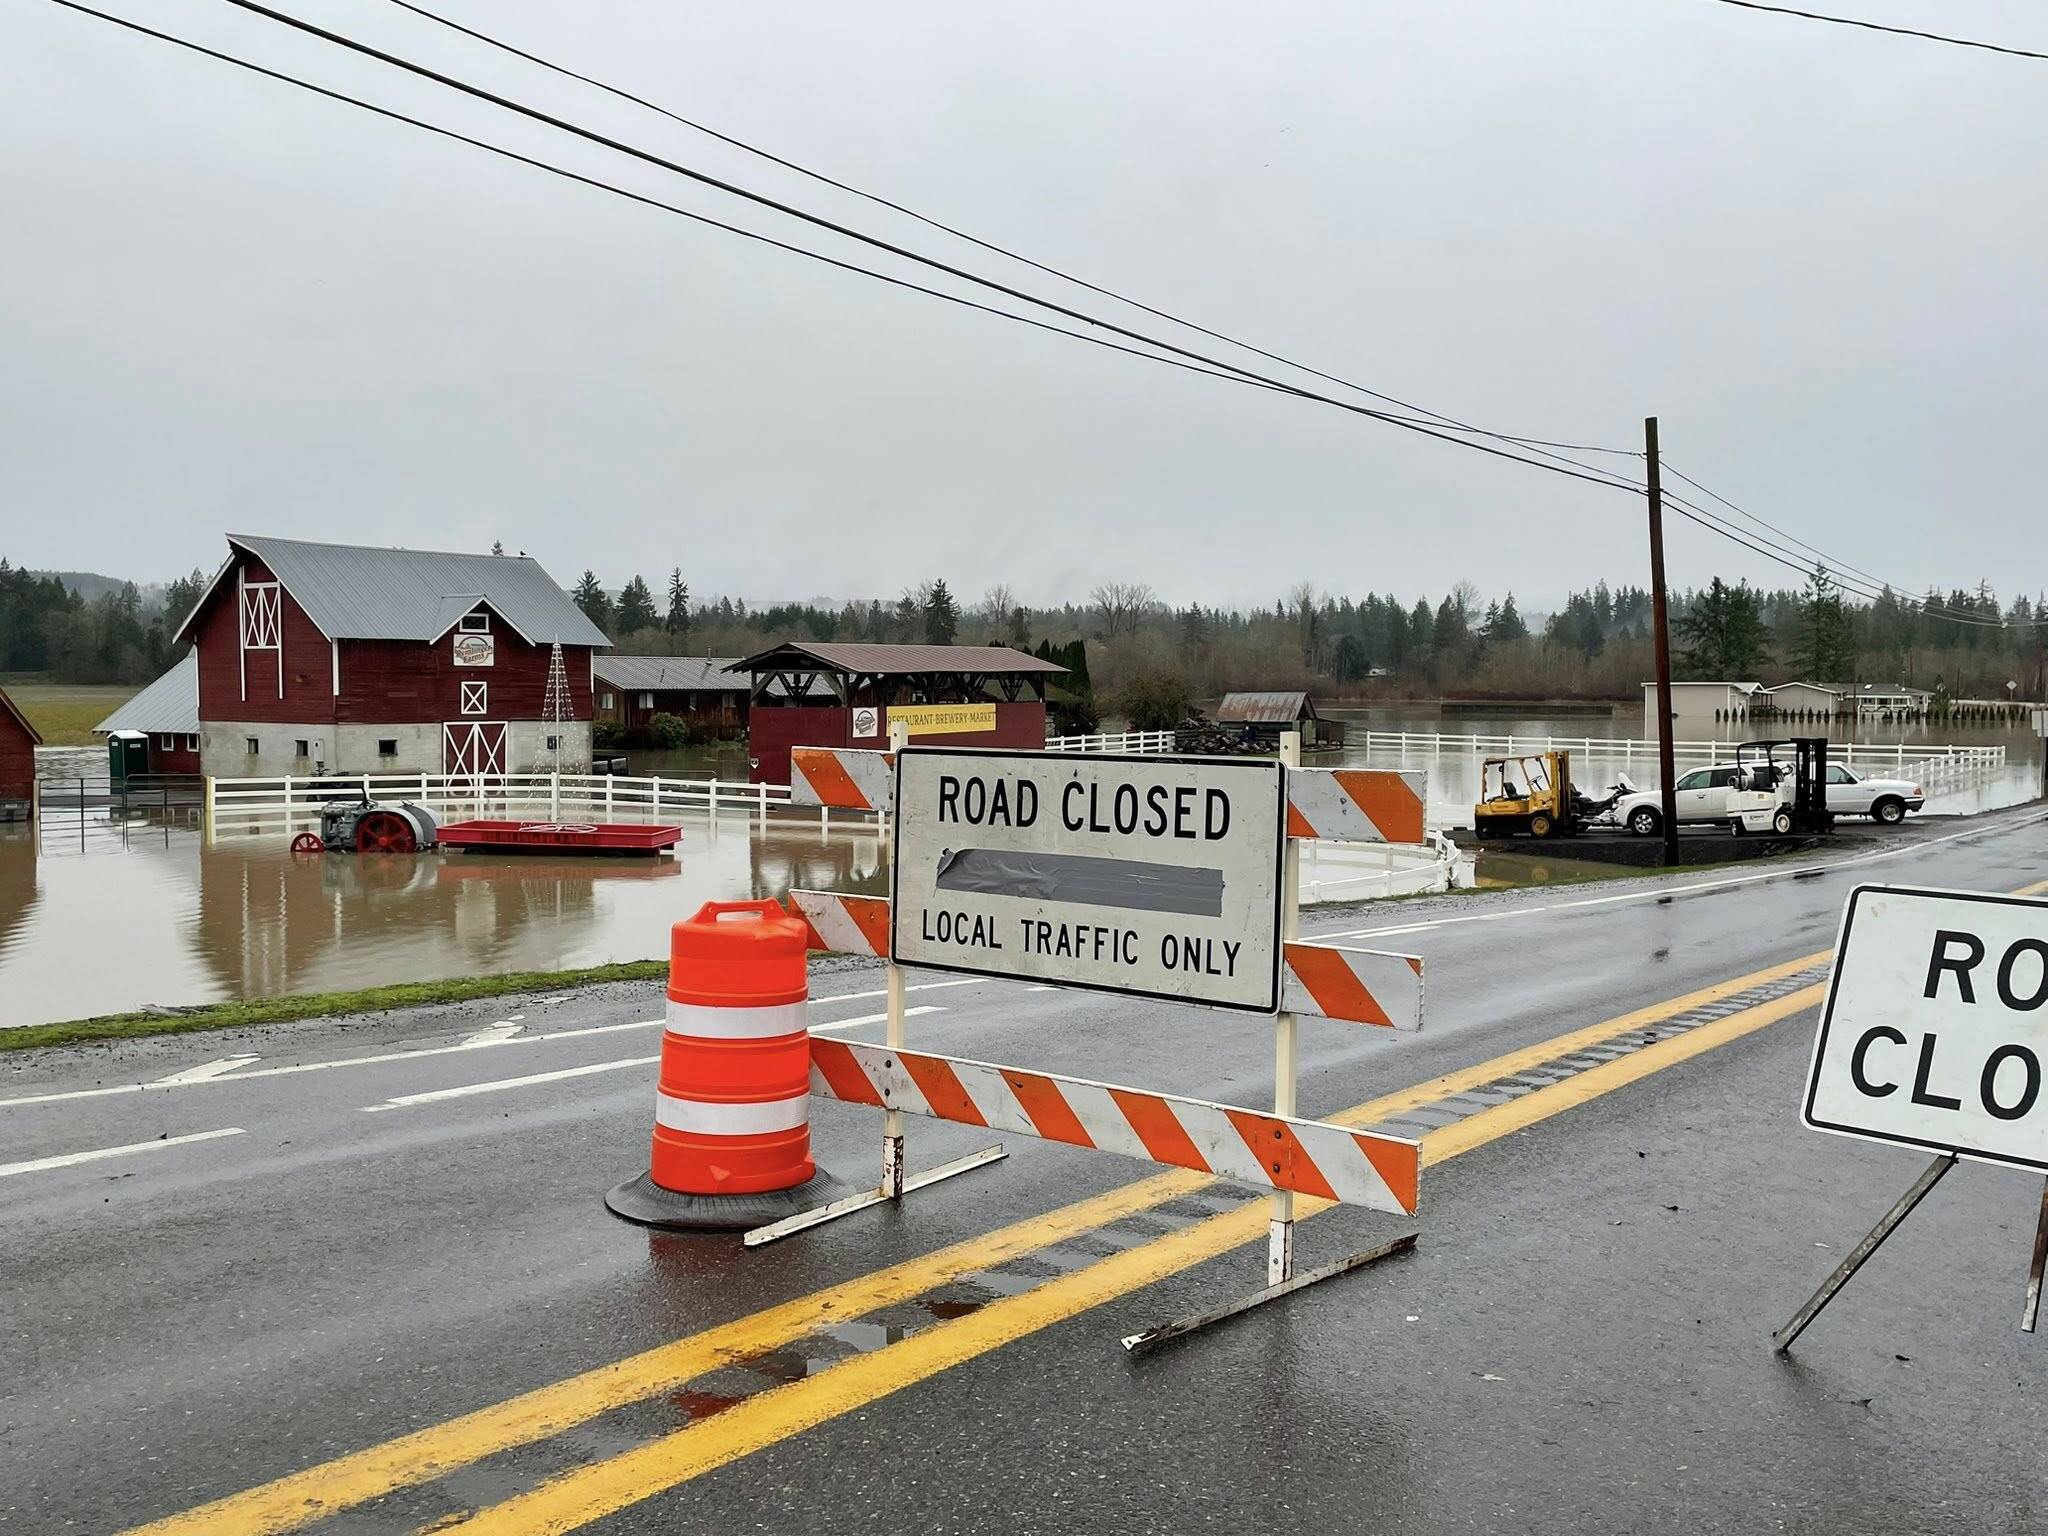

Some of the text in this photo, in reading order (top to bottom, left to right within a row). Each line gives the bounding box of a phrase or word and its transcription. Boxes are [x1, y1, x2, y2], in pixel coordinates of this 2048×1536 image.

[938, 775, 1231, 841] ROAD CLOSED
[922, 908, 1242, 978] LOCAL TRAFFIC ONLY
[1850, 1025, 2042, 1121] CLO
